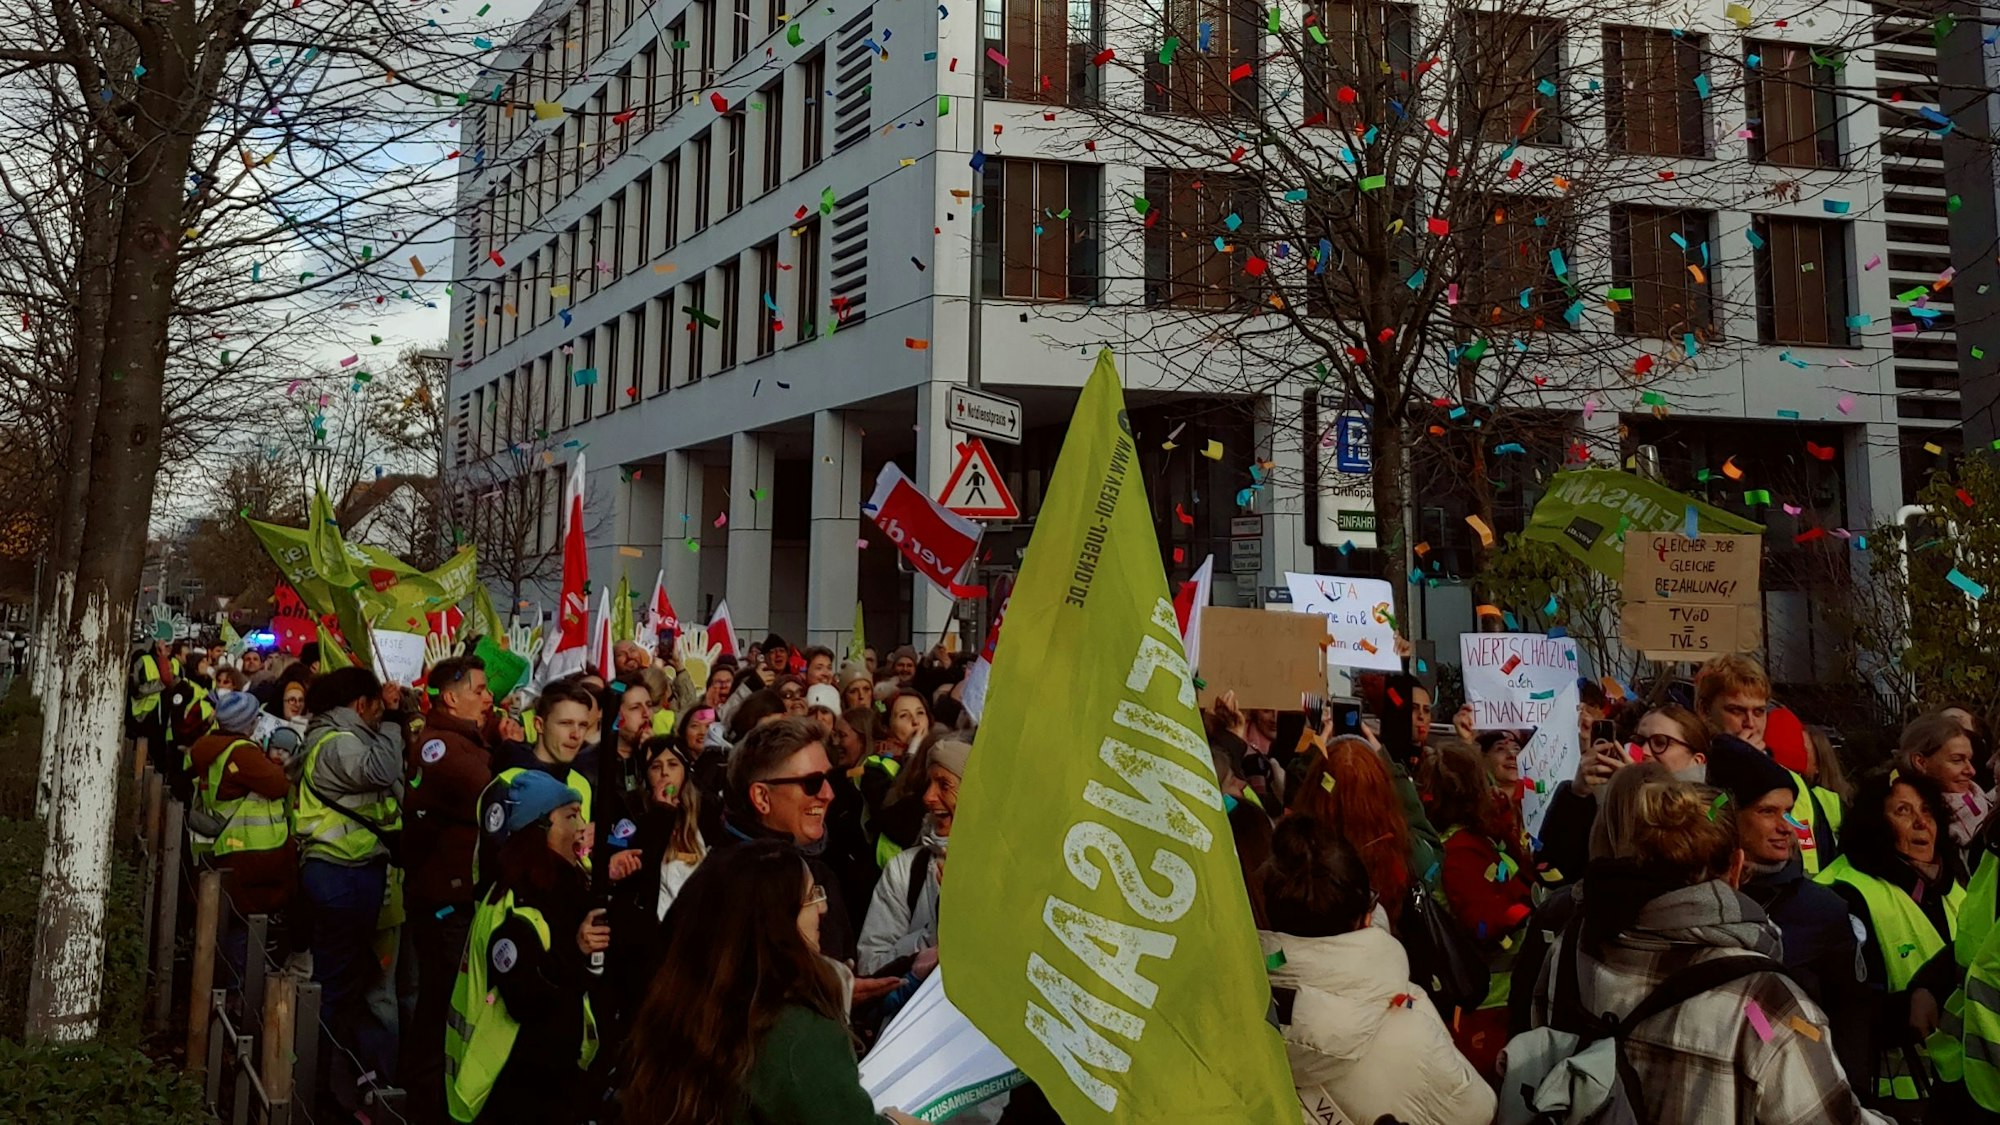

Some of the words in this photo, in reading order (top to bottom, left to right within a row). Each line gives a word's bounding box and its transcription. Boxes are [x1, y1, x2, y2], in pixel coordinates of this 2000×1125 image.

[967, 402, 1006, 427] Notdienstpraxis
[1332, 485, 1373, 499] Orthopä
[1653, 537, 1706, 553] GLEICHER
[1712, 540, 1735, 553] JOB
[1670, 560, 1716, 573] GLEICHE
[1655, 577, 1737, 598] BEZAHLUNG!
[1507, 677, 1533, 689] auch
[921, 1072, 1028, 1122] #ZUSAMMENGEHTME
